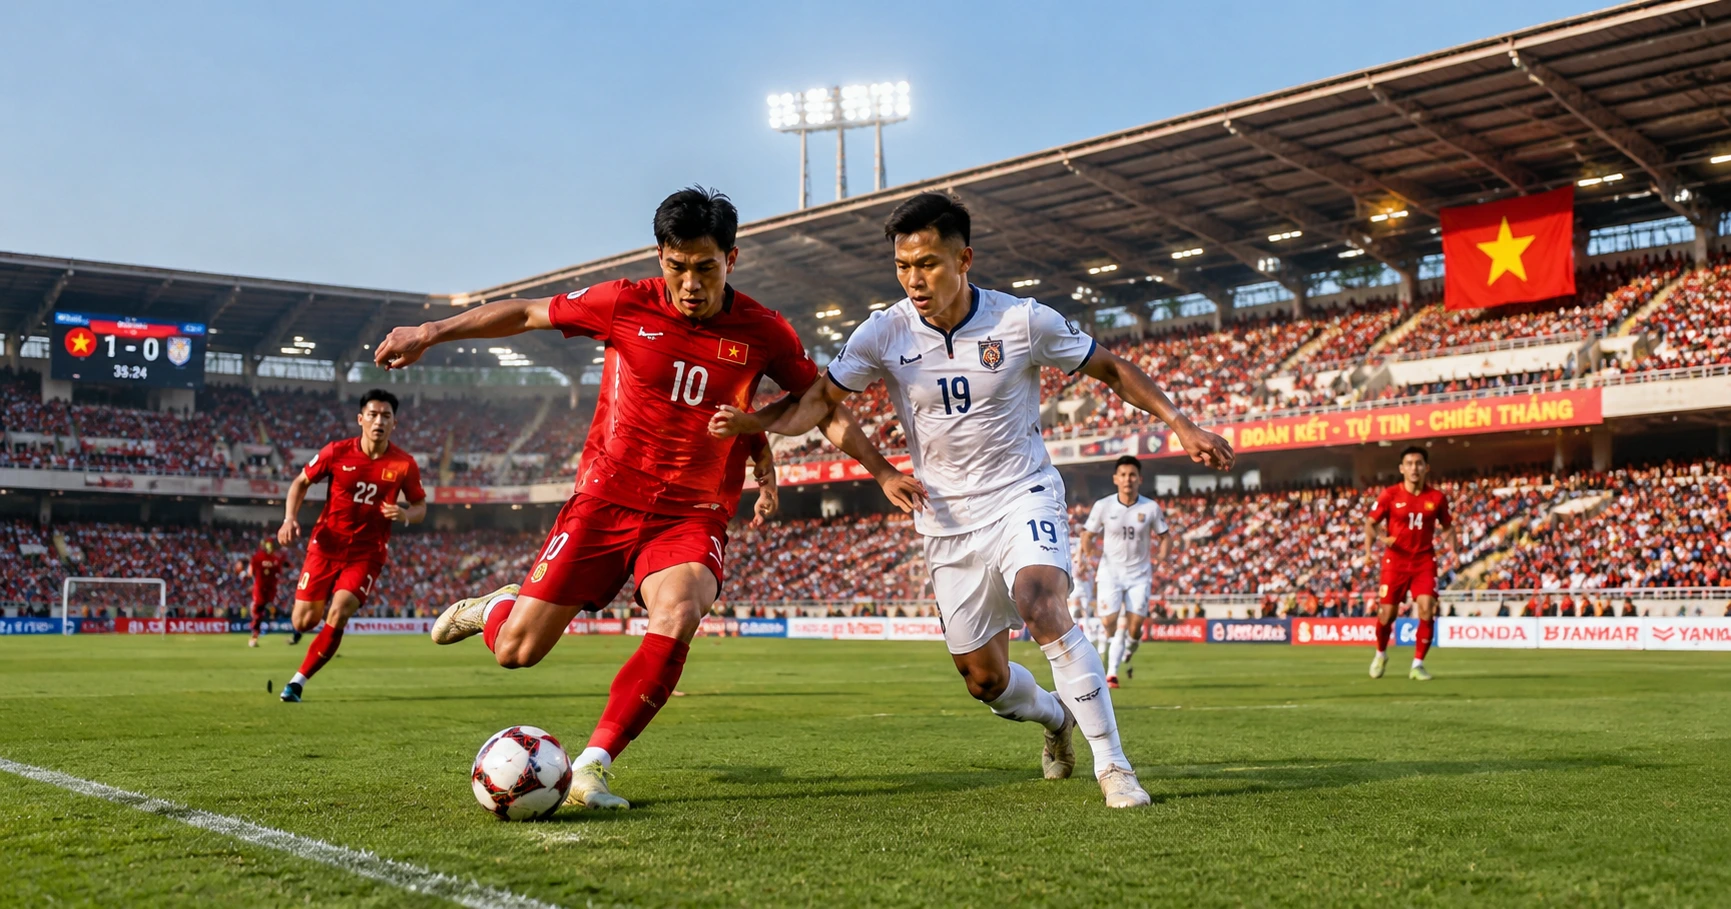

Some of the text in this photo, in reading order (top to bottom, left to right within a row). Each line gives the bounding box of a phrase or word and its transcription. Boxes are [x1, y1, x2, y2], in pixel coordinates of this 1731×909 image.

[104, 335, 116, 358] 1
[143, 337, 159, 361] 0
[671, 361, 709, 406] 10
[937, 375, 971, 415] 19
[1377, 413, 1410, 435] TIN
[353, 482, 377, 505] 22
[1026, 519, 1058, 544] 19
[1408, 512, 1423, 530] 14
[1449, 626, 1527, 640] HONDA
